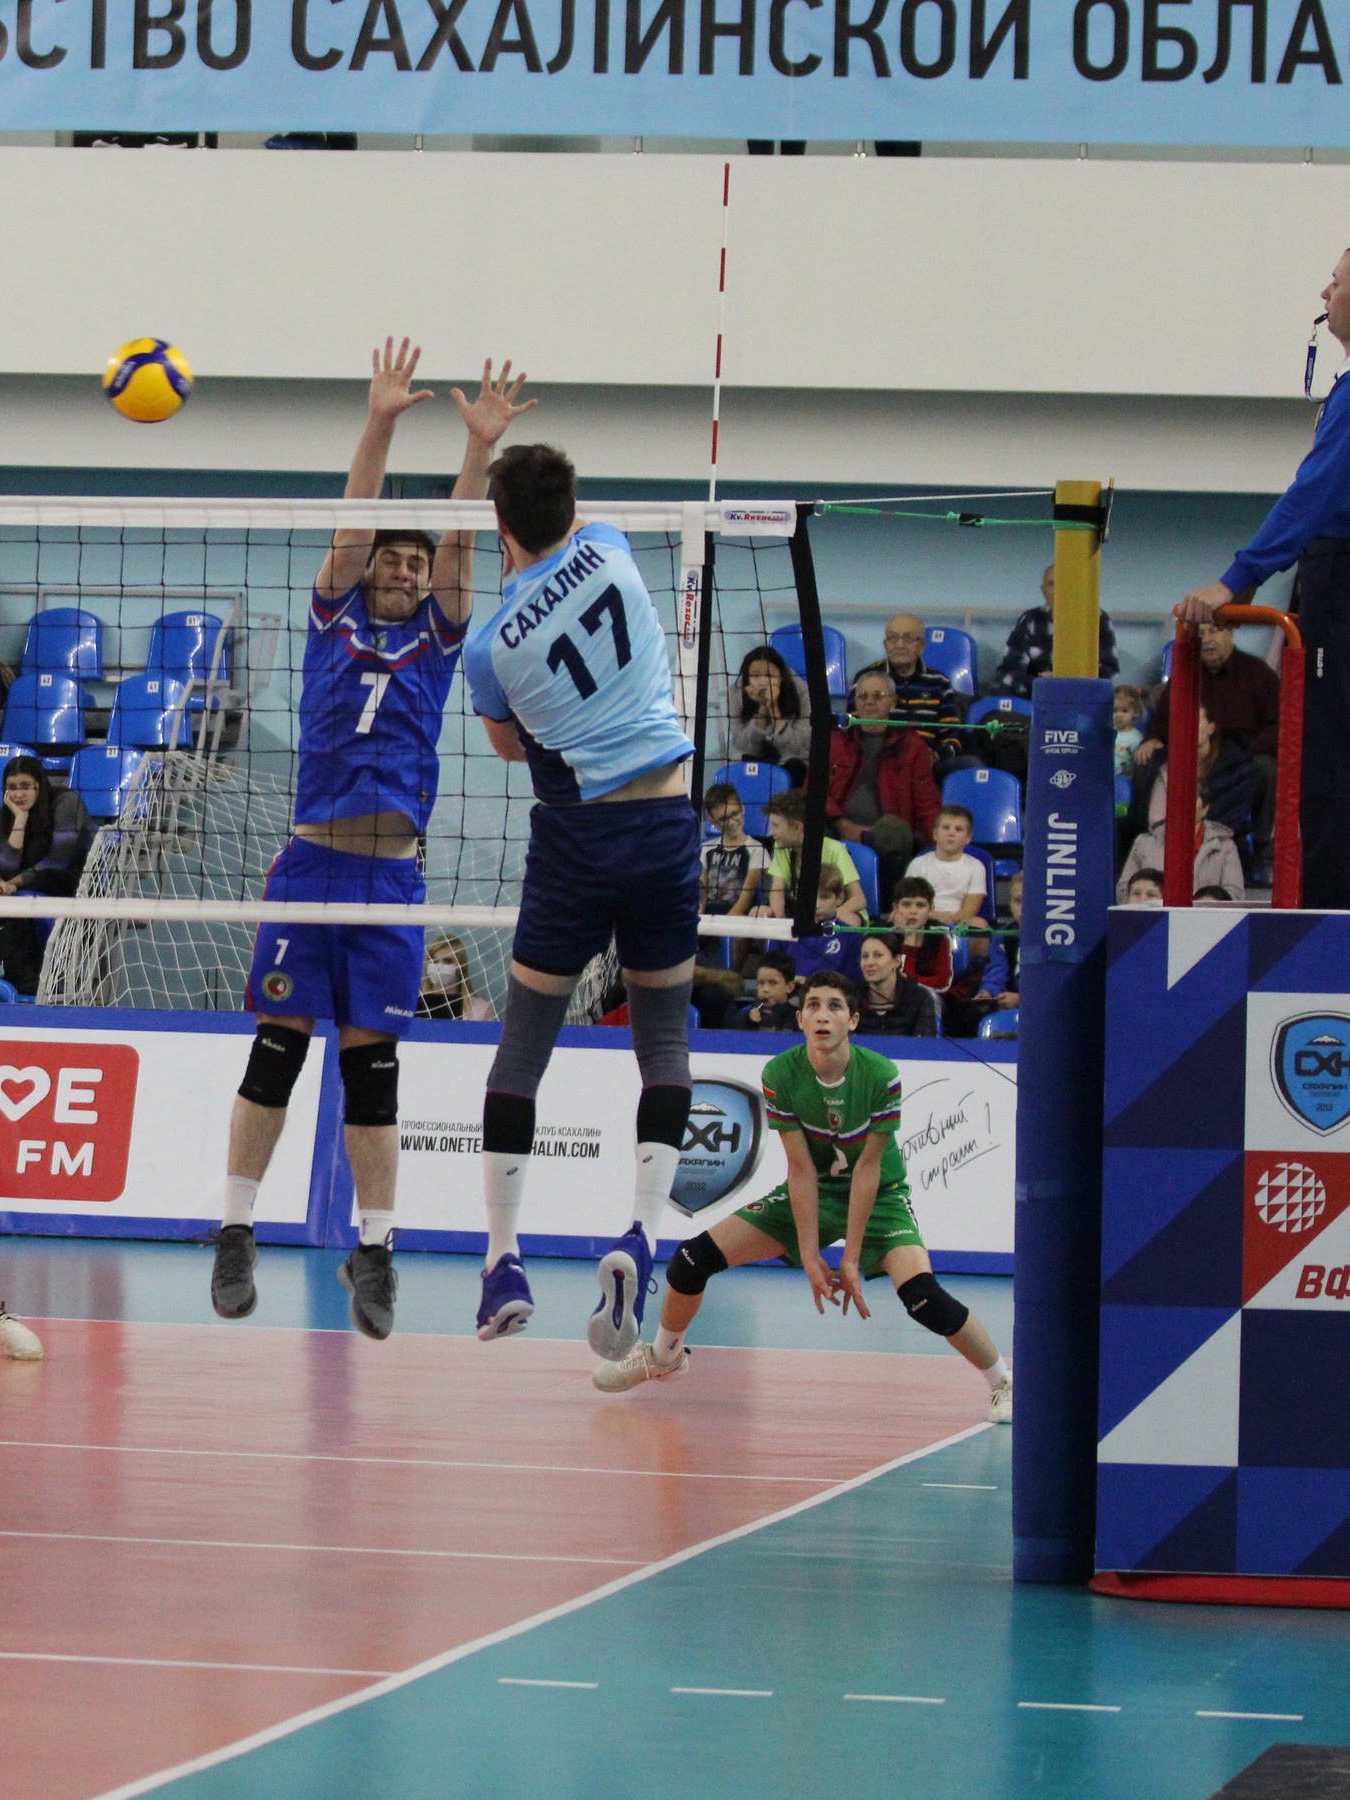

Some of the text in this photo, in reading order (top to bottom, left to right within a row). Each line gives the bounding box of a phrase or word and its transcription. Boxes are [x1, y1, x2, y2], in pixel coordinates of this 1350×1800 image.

[1073, 0, 1350, 84] ОБЛА
[500, 543, 606, 649] САХАЛИН
[546, 582, 632, 701] 17
[354, 671, 392, 734] 7
[712, 852, 741, 867] WIN
[1044, 812, 1078, 946] JINLING
[274, 938, 290, 966] 7
[16, 1139, 95, 1177] FM
[535, 1126, 556, 1135] КЛУБ
